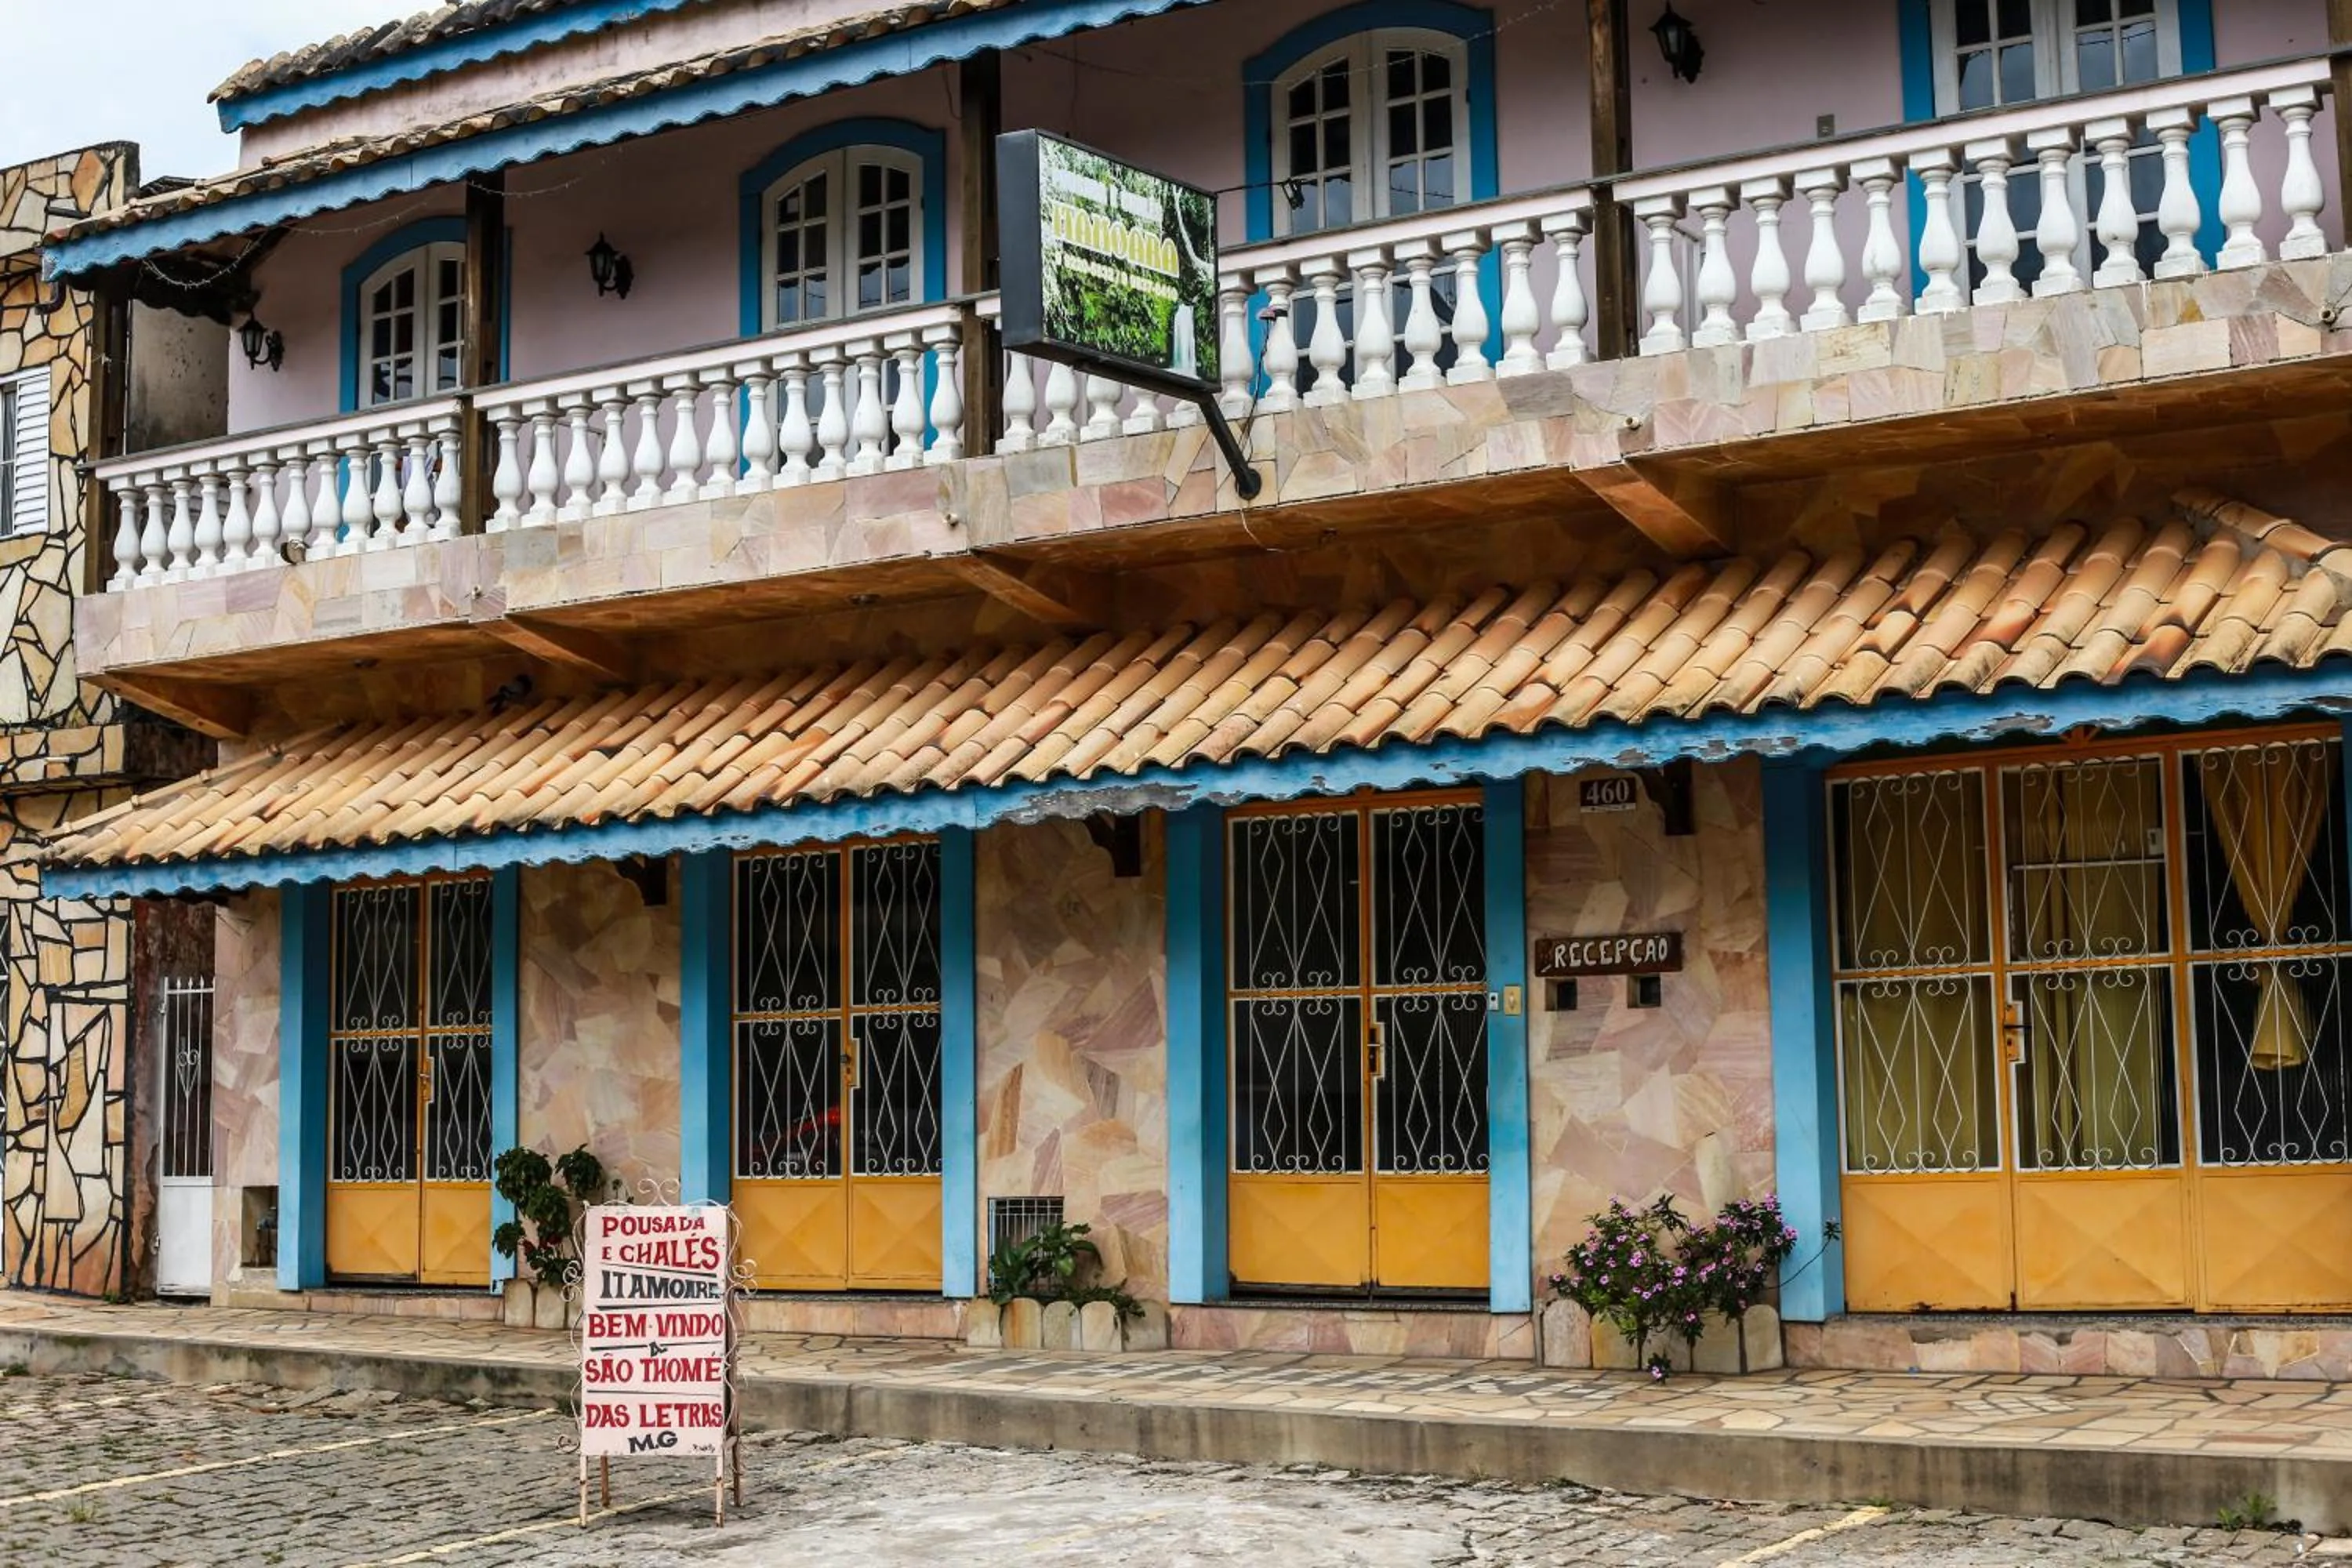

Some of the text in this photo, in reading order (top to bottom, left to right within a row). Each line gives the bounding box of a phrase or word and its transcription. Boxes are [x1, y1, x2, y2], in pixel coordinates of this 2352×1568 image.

[1586, 779, 1630, 804] 460
[601, 1216, 705, 1237] POUSADA
[601, 1232, 720, 1270] E CHALÉS
[587, 1313, 724, 1338] BEM VINDO
[639, 1351, 722, 1382] THOMÉ
[585, 1403, 724, 1428] DAS LETRAS
